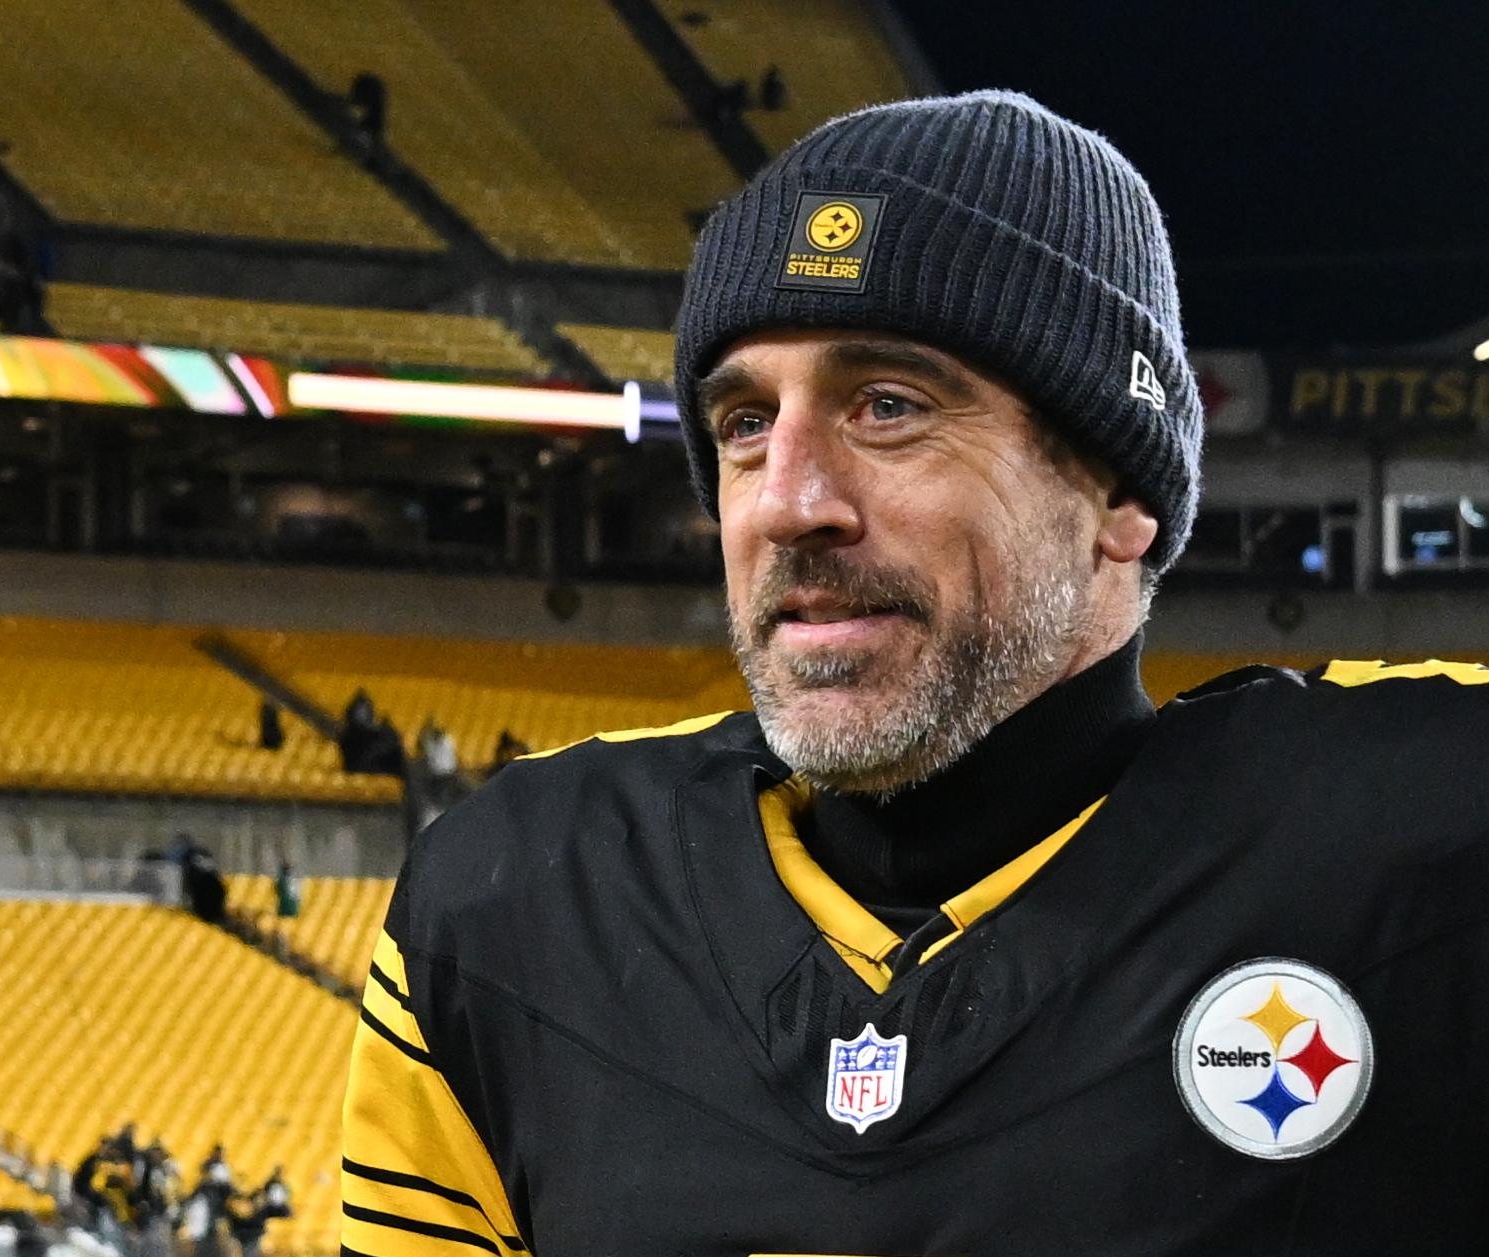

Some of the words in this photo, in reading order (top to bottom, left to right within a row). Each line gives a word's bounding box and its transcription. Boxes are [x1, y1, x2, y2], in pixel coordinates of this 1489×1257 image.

[789, 253, 862, 264] PITTSBURGH
[786, 261, 860, 279] STEELERS
[1197, 1045, 1271, 1067] Steelers
[838, 1075, 887, 1112] NFL
